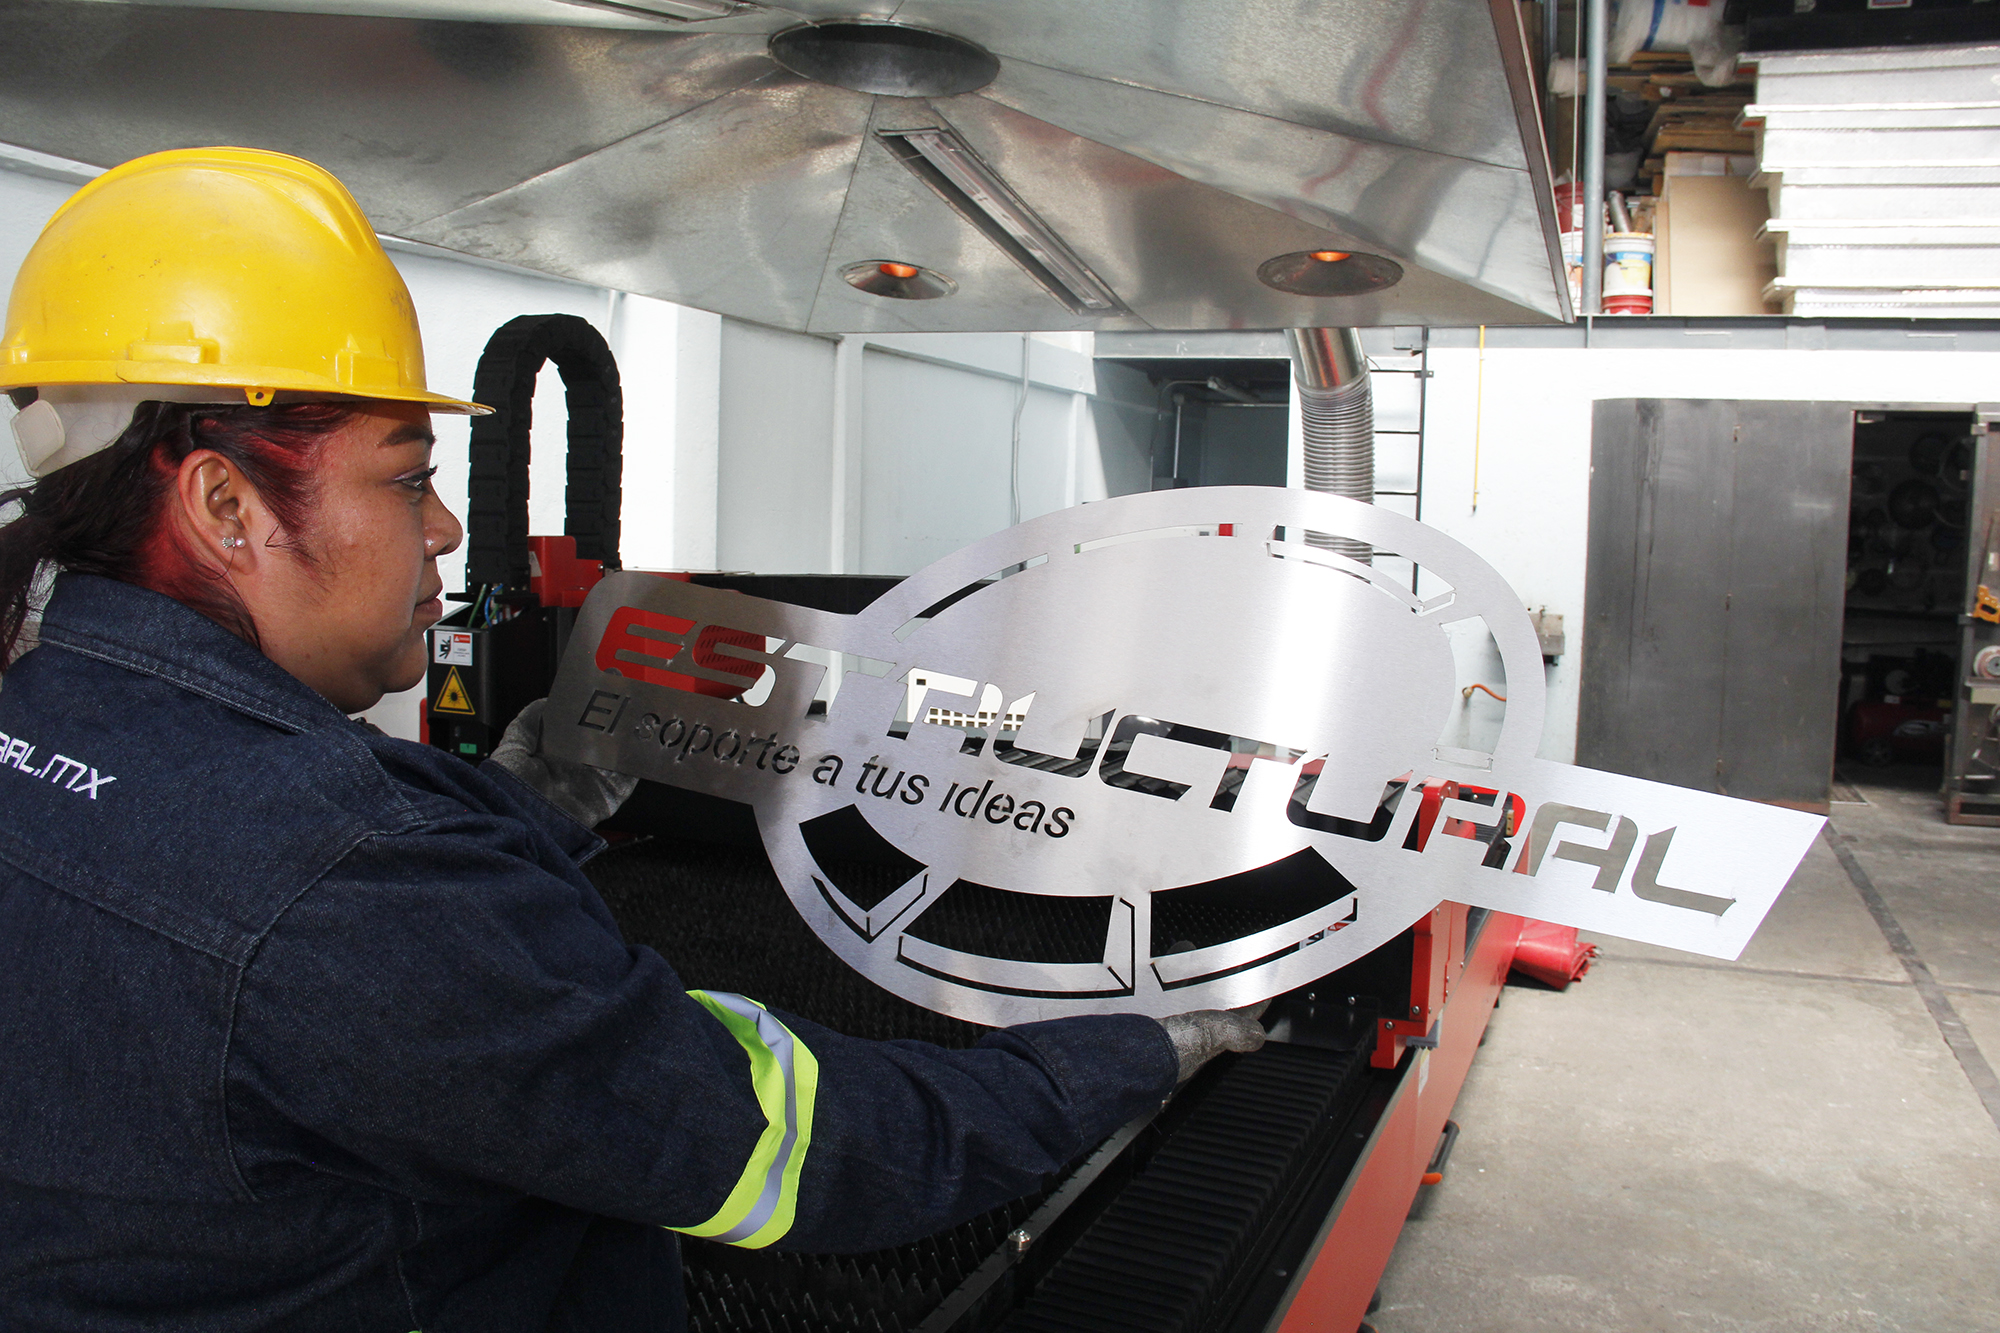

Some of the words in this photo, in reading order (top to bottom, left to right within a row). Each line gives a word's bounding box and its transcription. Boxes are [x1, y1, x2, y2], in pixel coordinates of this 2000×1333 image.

[577, 689, 631, 735] El
[633, 711, 800, 775] soporte
[812, 754, 844, 787] a
[855, 754, 930, 806] tus
[938, 779, 1076, 839] ideas
[594, 605, 1737, 917] ESTRUCTURAL
